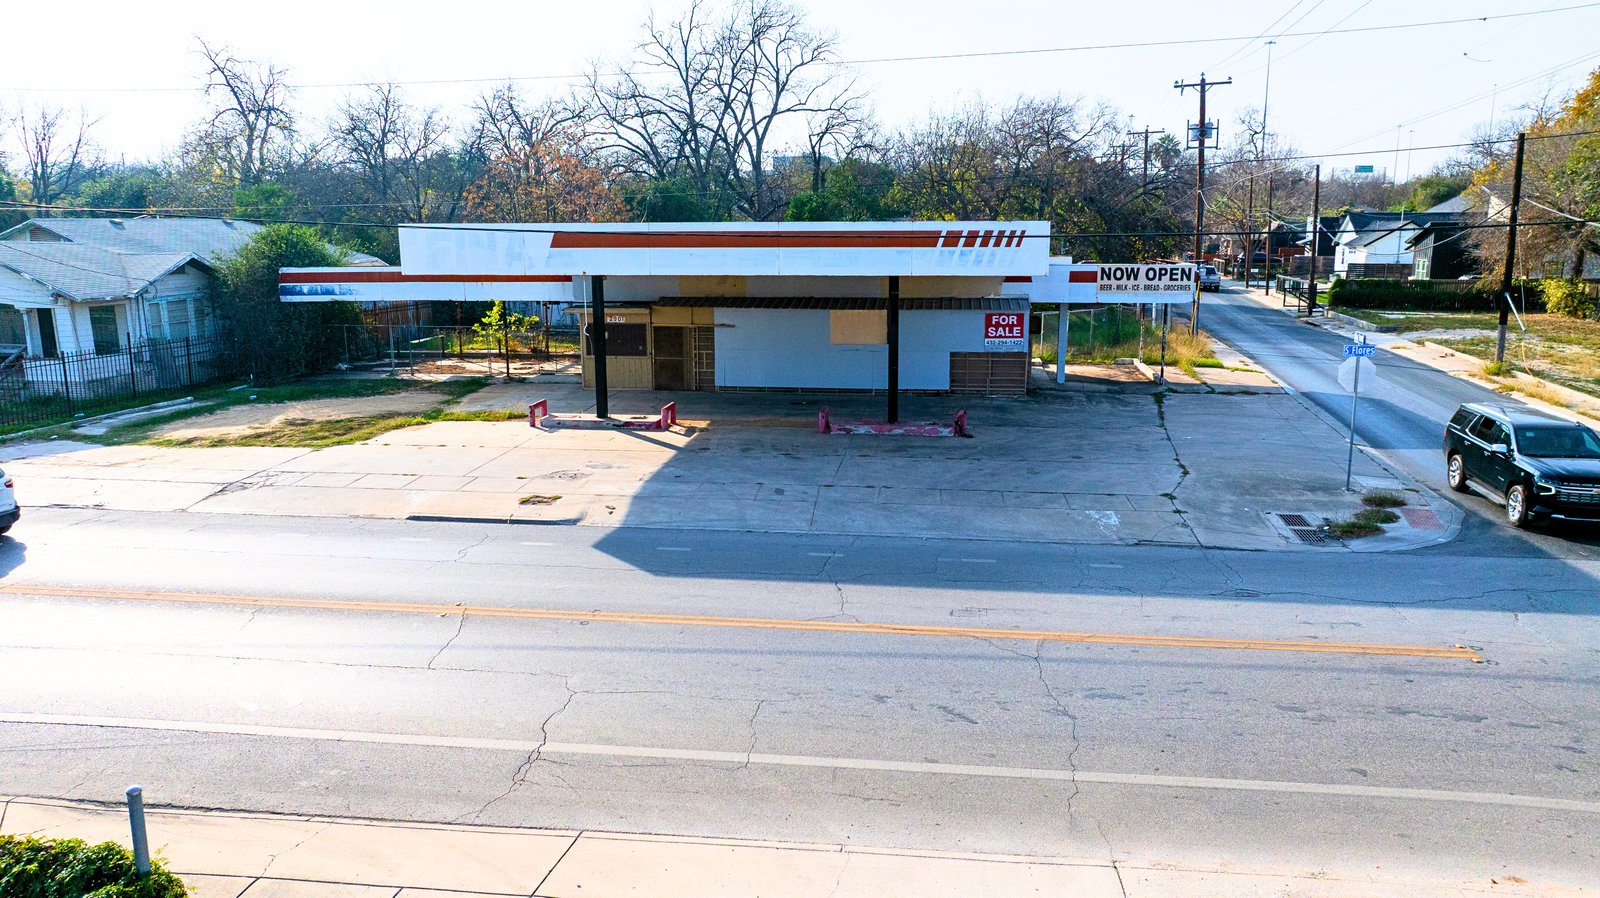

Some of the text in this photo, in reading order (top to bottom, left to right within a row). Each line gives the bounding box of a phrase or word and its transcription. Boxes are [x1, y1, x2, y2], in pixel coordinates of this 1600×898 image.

[1100, 266, 1192, 282] NOW OPEN
[992, 315, 1017, 325] FOR
[988, 327, 1021, 337] SALE
[1345, 346, 1375, 354] S Flores
